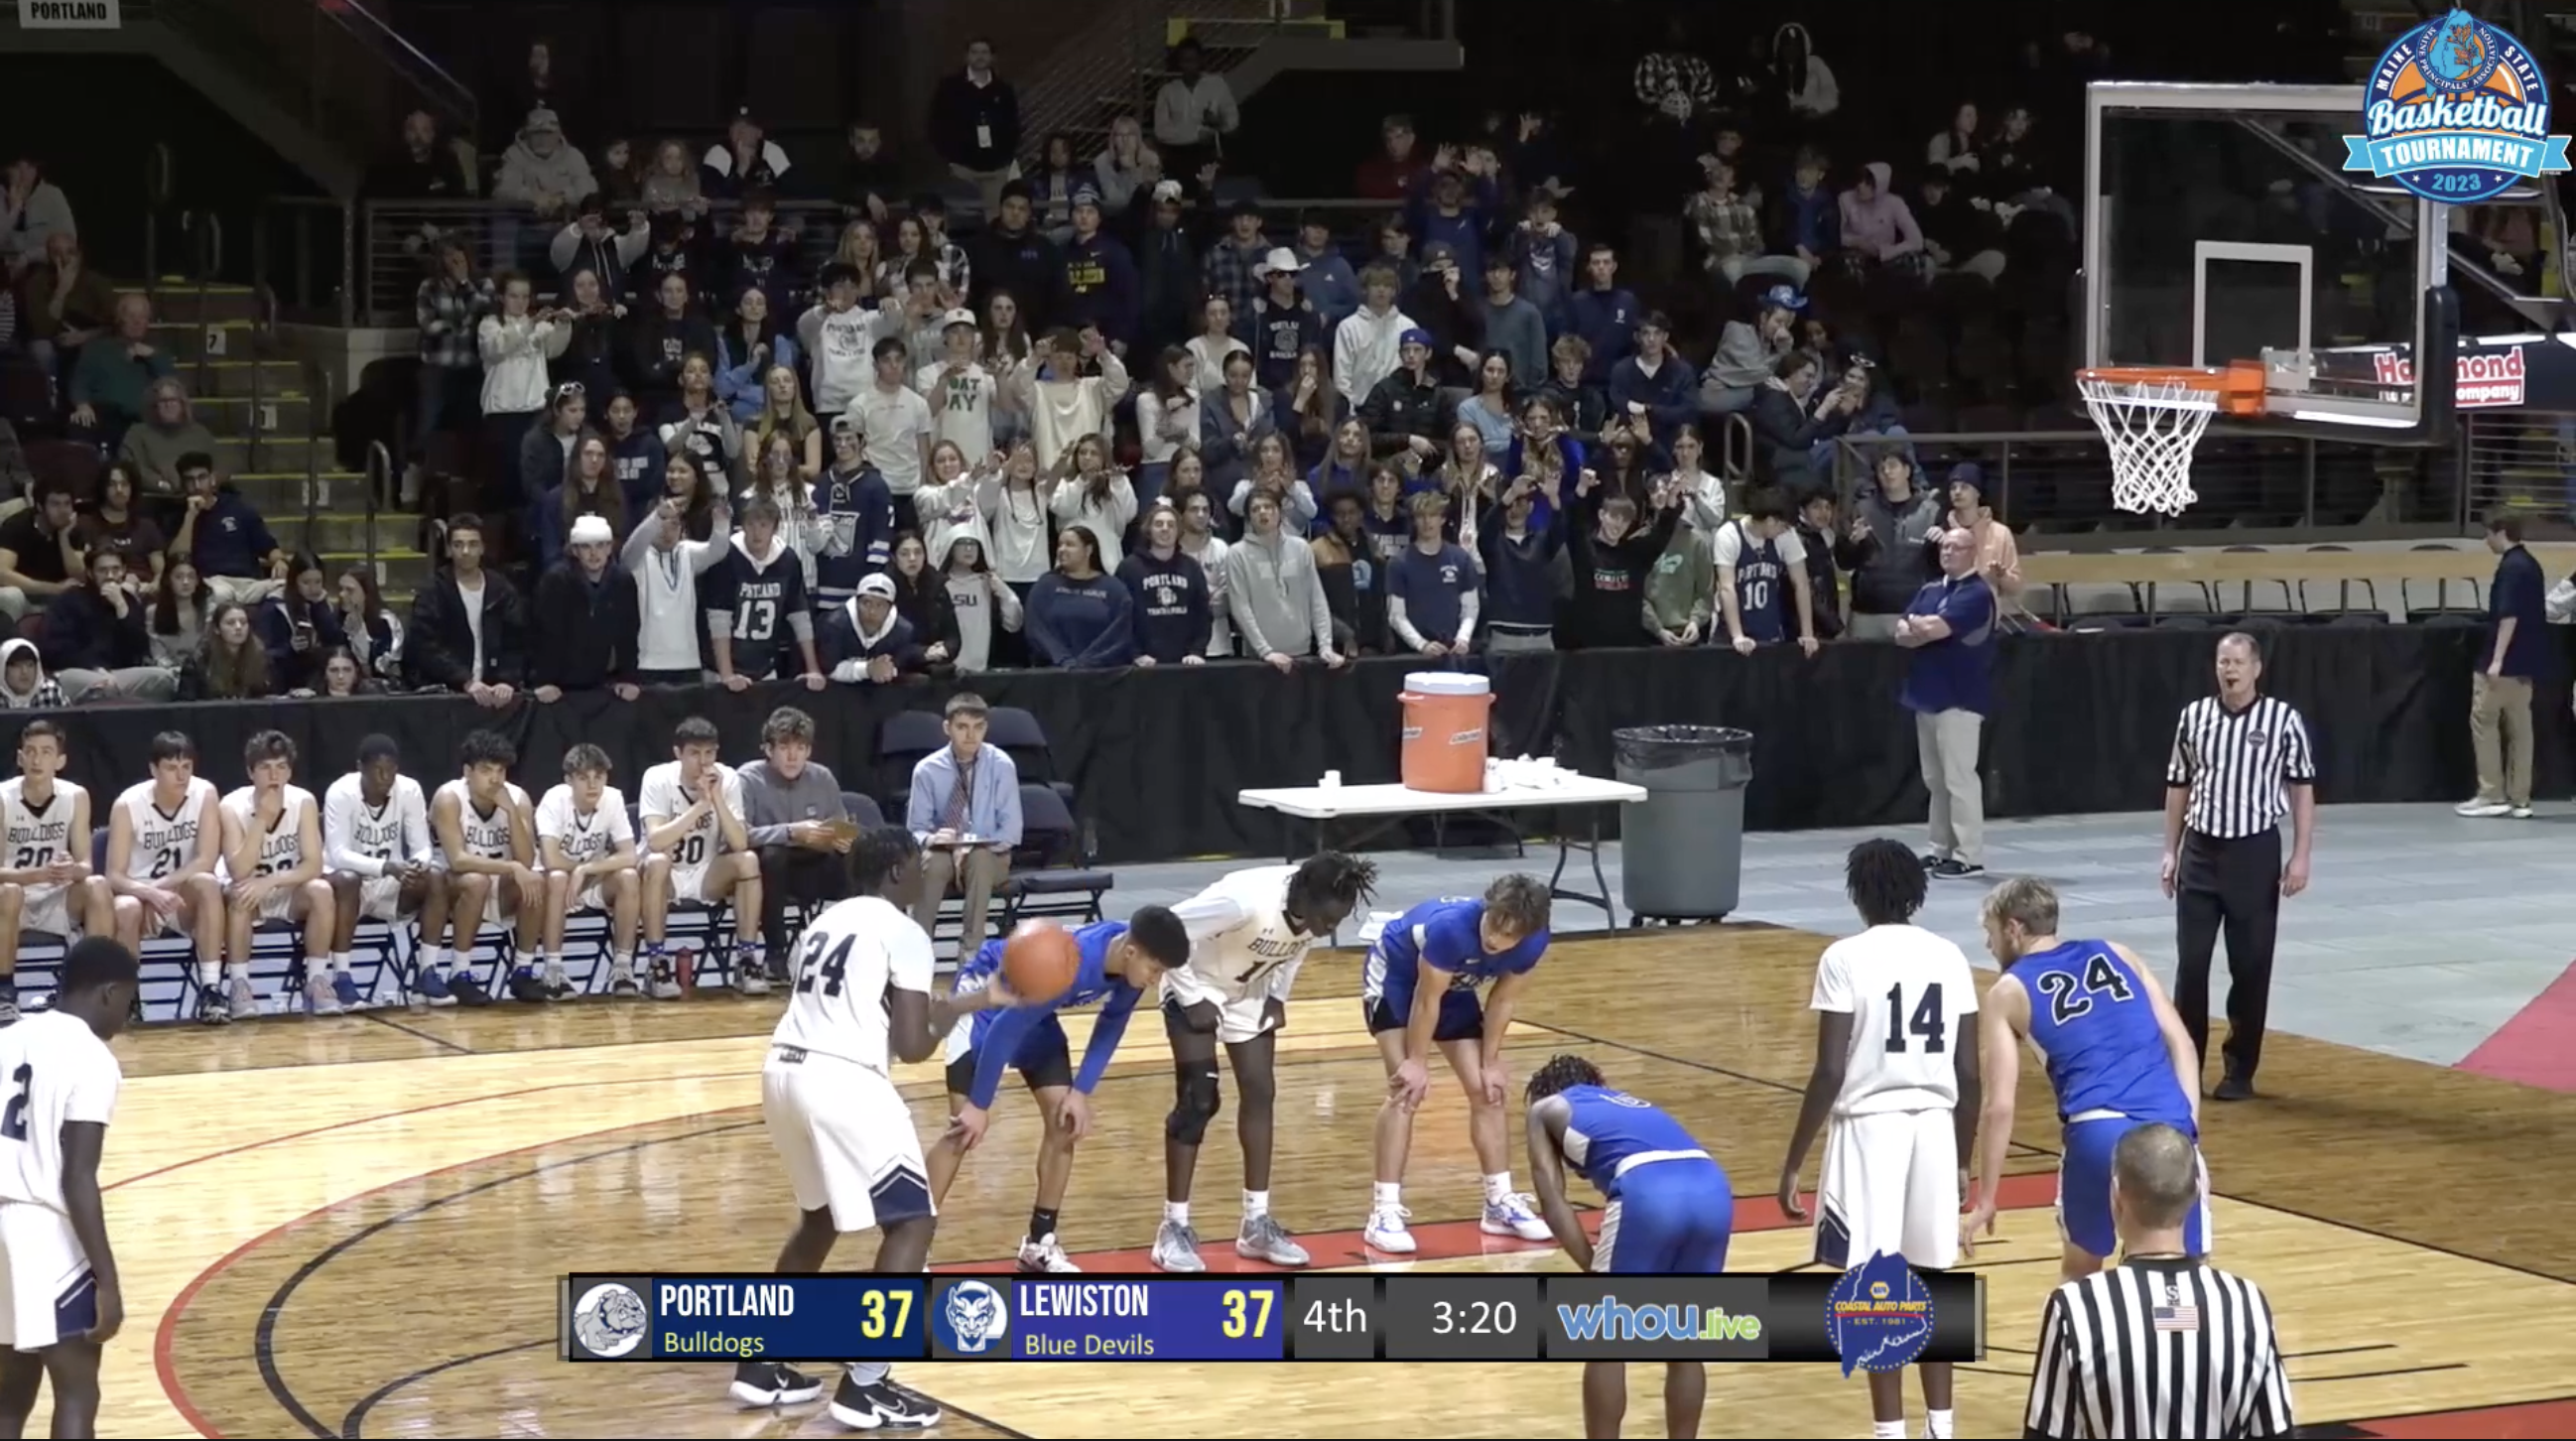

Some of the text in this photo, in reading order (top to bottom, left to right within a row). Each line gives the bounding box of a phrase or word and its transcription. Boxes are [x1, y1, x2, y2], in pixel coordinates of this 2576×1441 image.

[31, 2, 106, 20] PORTLAND
[2455, 383, 2519, 402] ompany
[1743, 581, 1767, 610] 10
[733, 599, 776, 640] 13
[8, 822, 65, 844] BULLDOGS
[144, 821, 197, 851] BULLDOGS
[150, 847, 182, 879] 21
[672, 835, 705, 865] 30
[796, 931, 857, 998] 24
[2036, 952, 2134, 1026] 24
[1884, 982, 1945, 1054] 14
